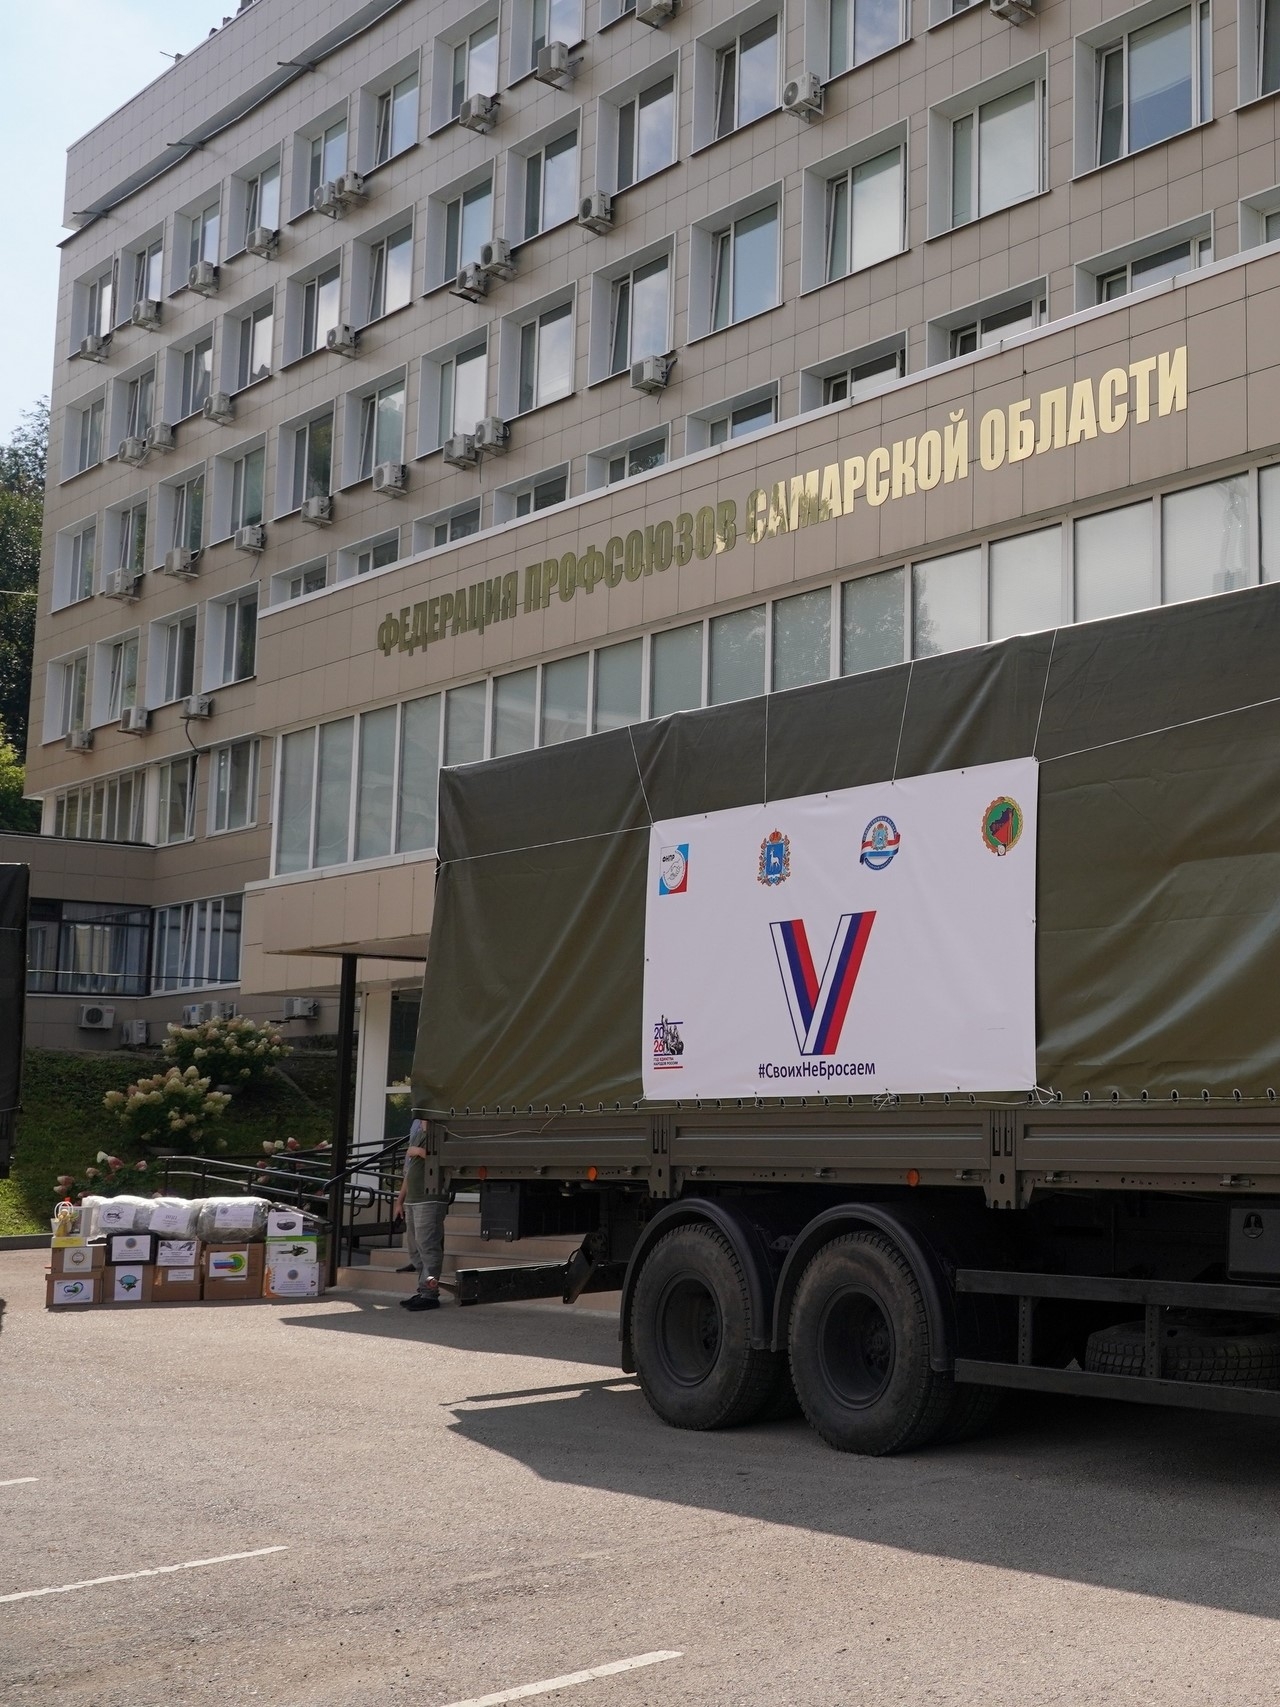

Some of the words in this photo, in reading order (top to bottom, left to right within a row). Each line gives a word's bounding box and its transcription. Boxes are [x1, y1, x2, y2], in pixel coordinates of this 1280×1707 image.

[377, 571, 518, 656] ФЕДЕРАЦИЯ
[524, 499, 737, 614] ПРОФСОЮЗОВ
[745, 408, 968, 544] САМАРСКОЙ
[980, 346, 1187, 472] ОБЛАСТИ
[662, 854, 675, 862] ФНПР
[769, 911, 877, 1055] V
[654, 1026, 664, 1039] 20
[654, 1040, 665, 1052] 26
[758, 1061, 876, 1080] #СвоихНеБросаем
